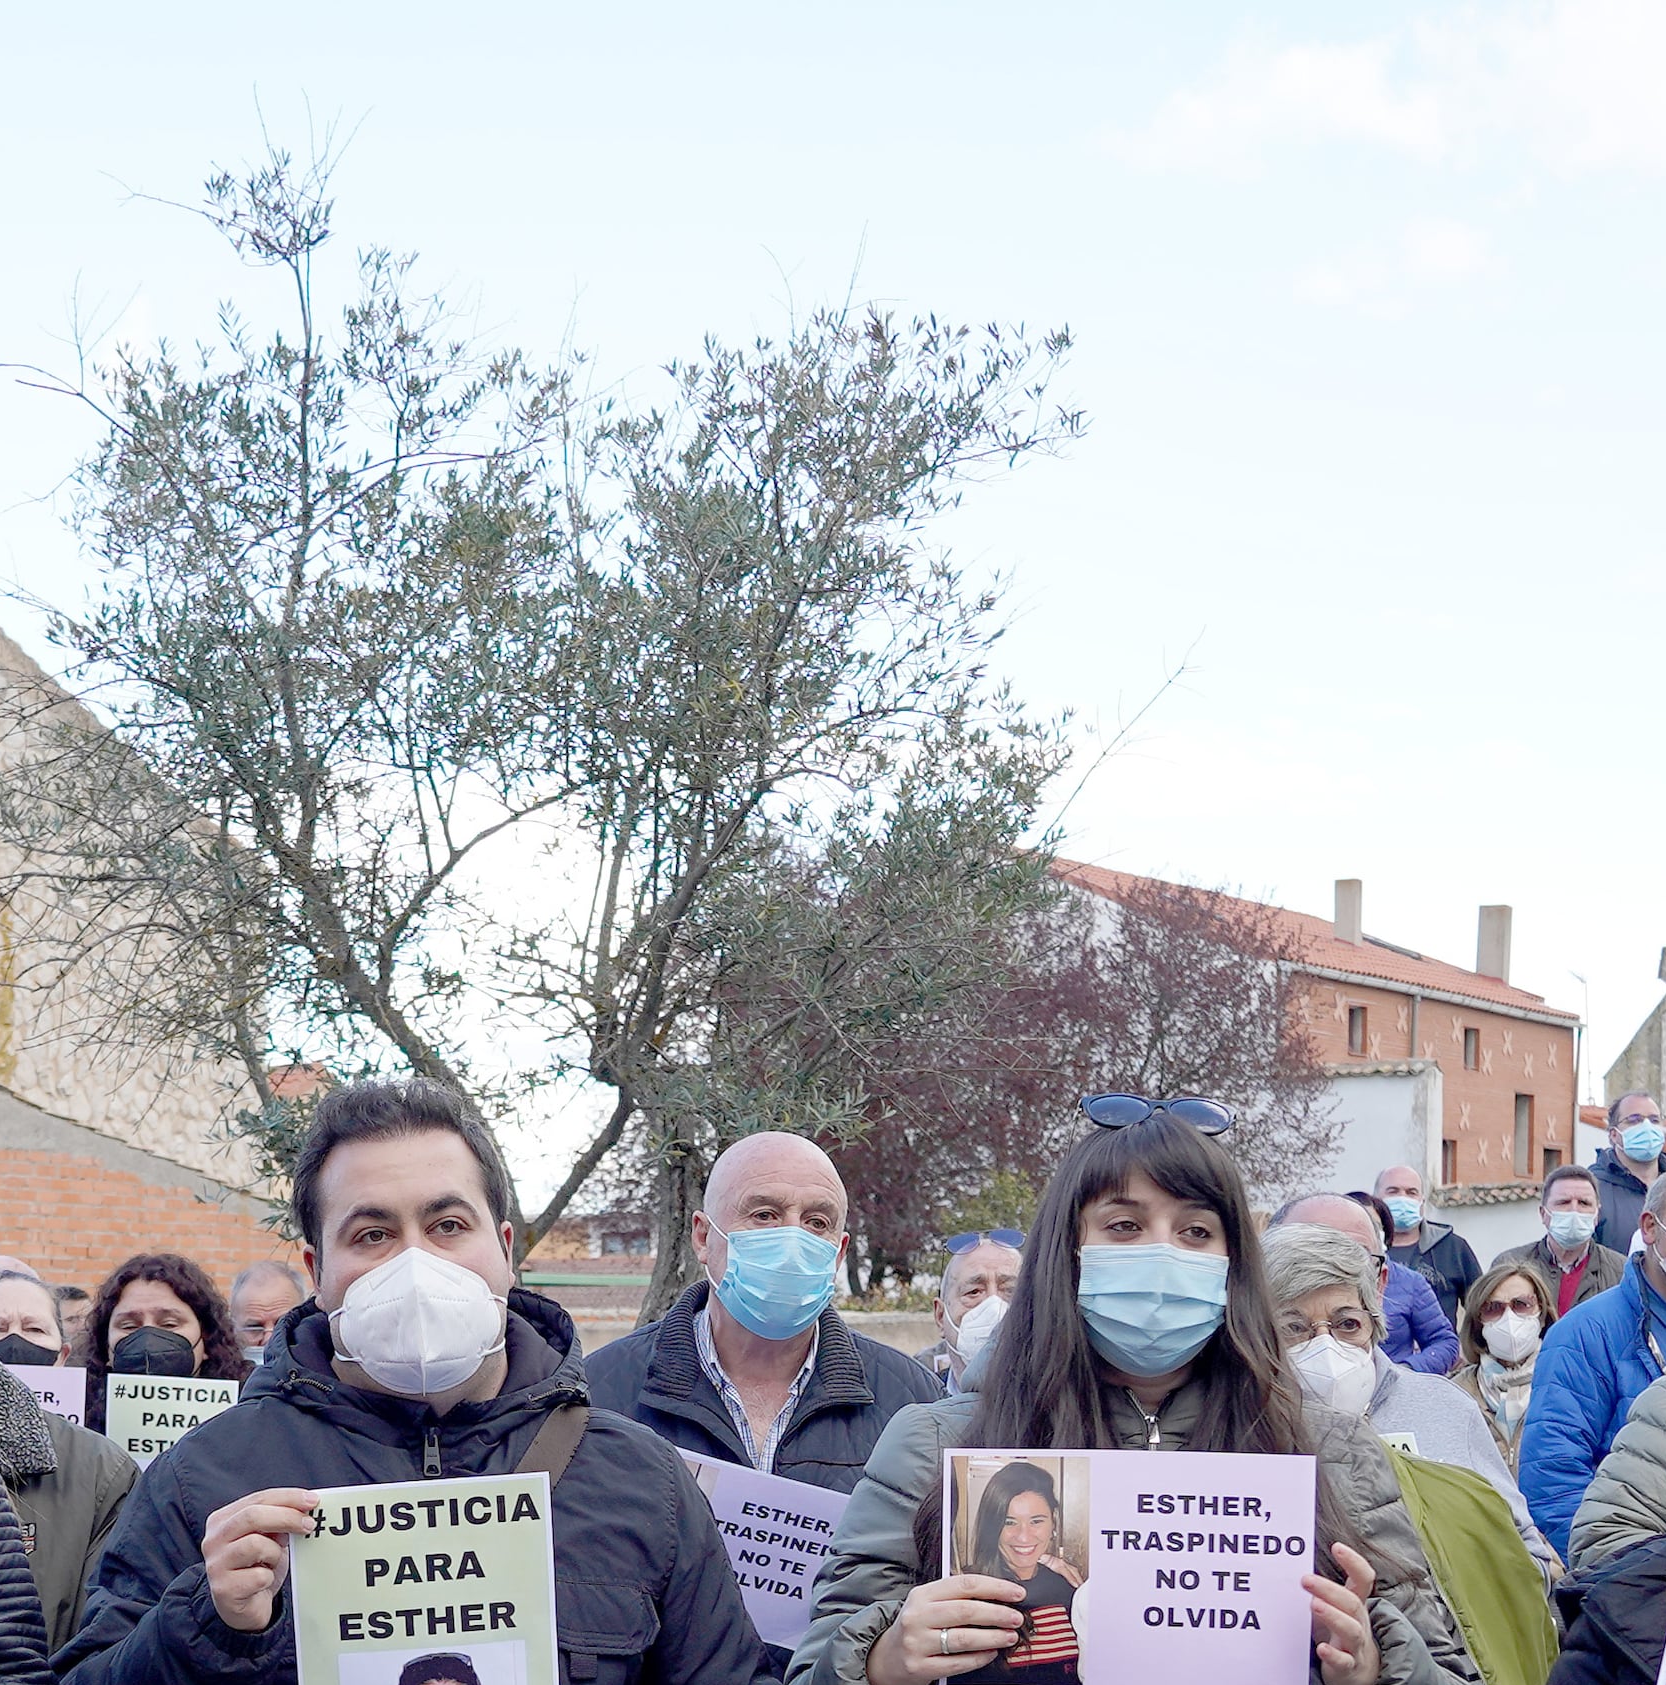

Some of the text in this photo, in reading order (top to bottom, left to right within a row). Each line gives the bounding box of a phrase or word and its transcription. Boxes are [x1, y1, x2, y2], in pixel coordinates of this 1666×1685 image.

[114, 1383, 232, 1404] #JUSTICIA
[142, 1412, 199, 1429] PARA
[305, 1493, 541, 1538] #JUSTICIA
[741, 1501, 834, 1538] ESTHER,
[1137, 1494, 1271, 1522] ESTHER,
[1101, 1530, 1306, 1556] TRASPINEDO
[365, 1551, 486, 1587] PARA
[738, 1549, 807, 1576] NO TE
[1156, 1569, 1251, 1592] NO TE
[339, 1601, 517, 1641] ESTHER
[1144, 1606, 1261, 1630] OLVIDA
